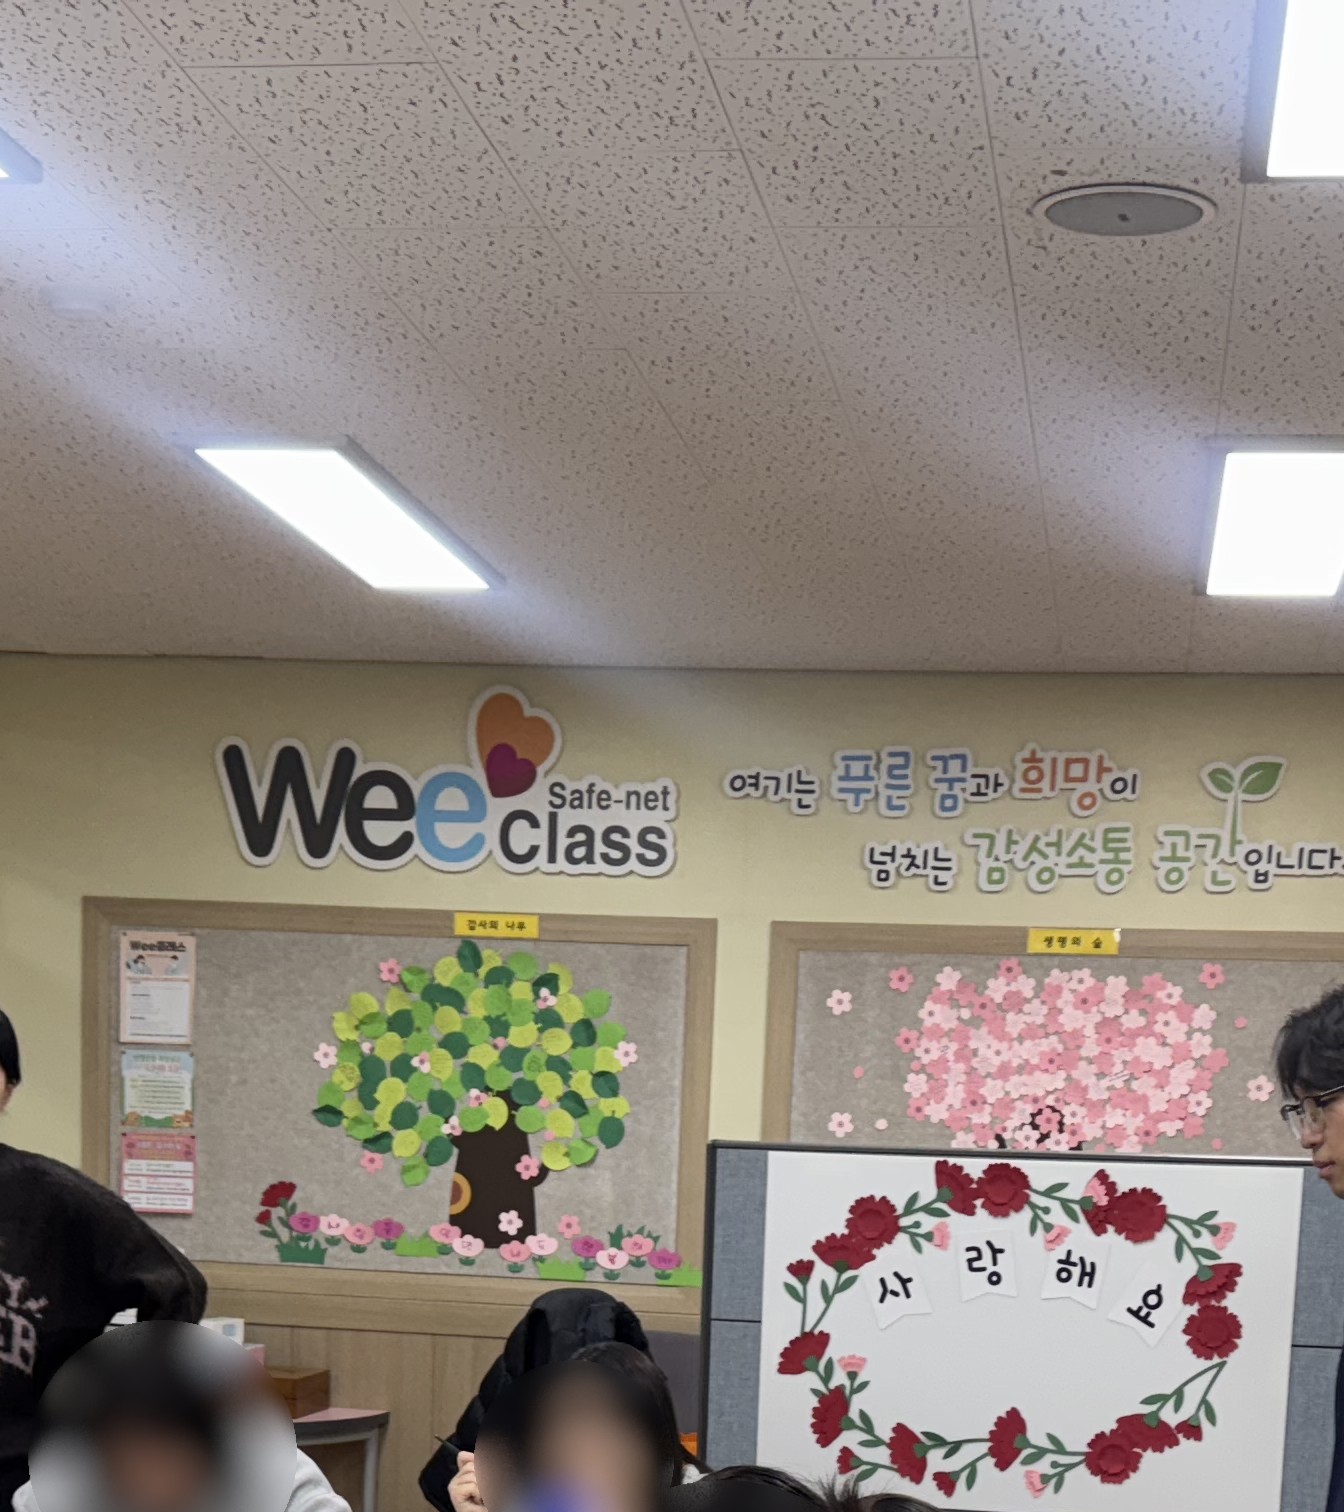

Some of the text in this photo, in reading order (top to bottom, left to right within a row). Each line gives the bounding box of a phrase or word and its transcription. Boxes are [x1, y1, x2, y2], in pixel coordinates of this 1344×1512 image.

[222, 744, 488, 863] Wee
[547, 782, 671, 811] Safe-net
[728, 749, 1139, 813] 여기는 푸른 꿈과 희망이
[868, 846, 953, 886] 넘치는
[972, 826, 1132, 887] 감성소통
